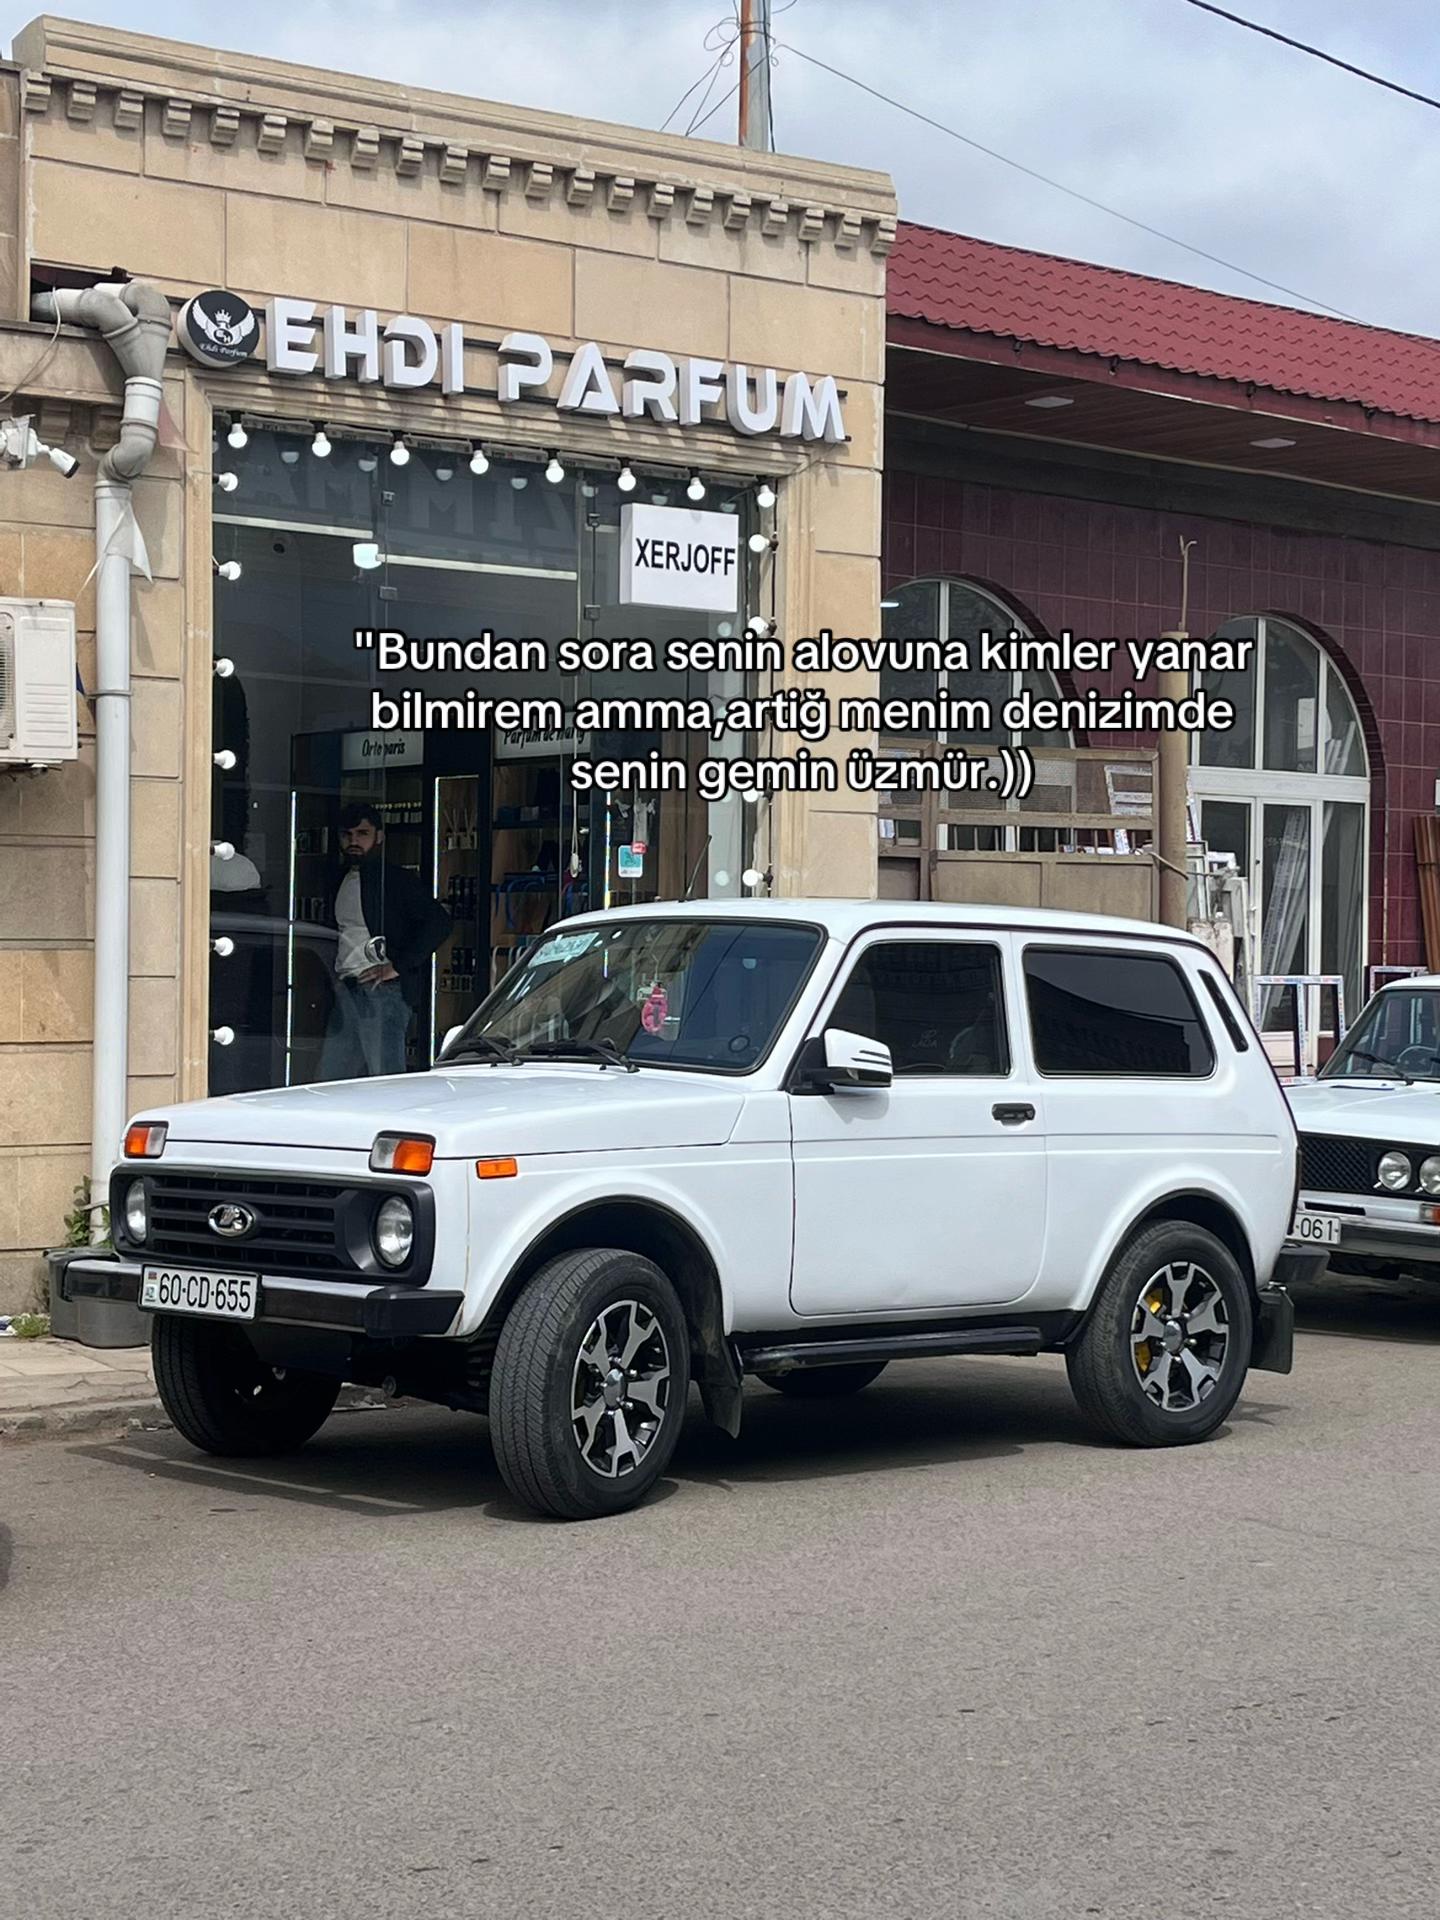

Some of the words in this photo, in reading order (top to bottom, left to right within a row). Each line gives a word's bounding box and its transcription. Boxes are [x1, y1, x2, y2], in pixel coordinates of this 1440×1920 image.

[265, 297, 465, 396] EHDI
[497, 332, 846, 443] PARFUM
[634, 537, 736, 576] XERJOFF
[1300, 1217, 1333, 1241] 061
